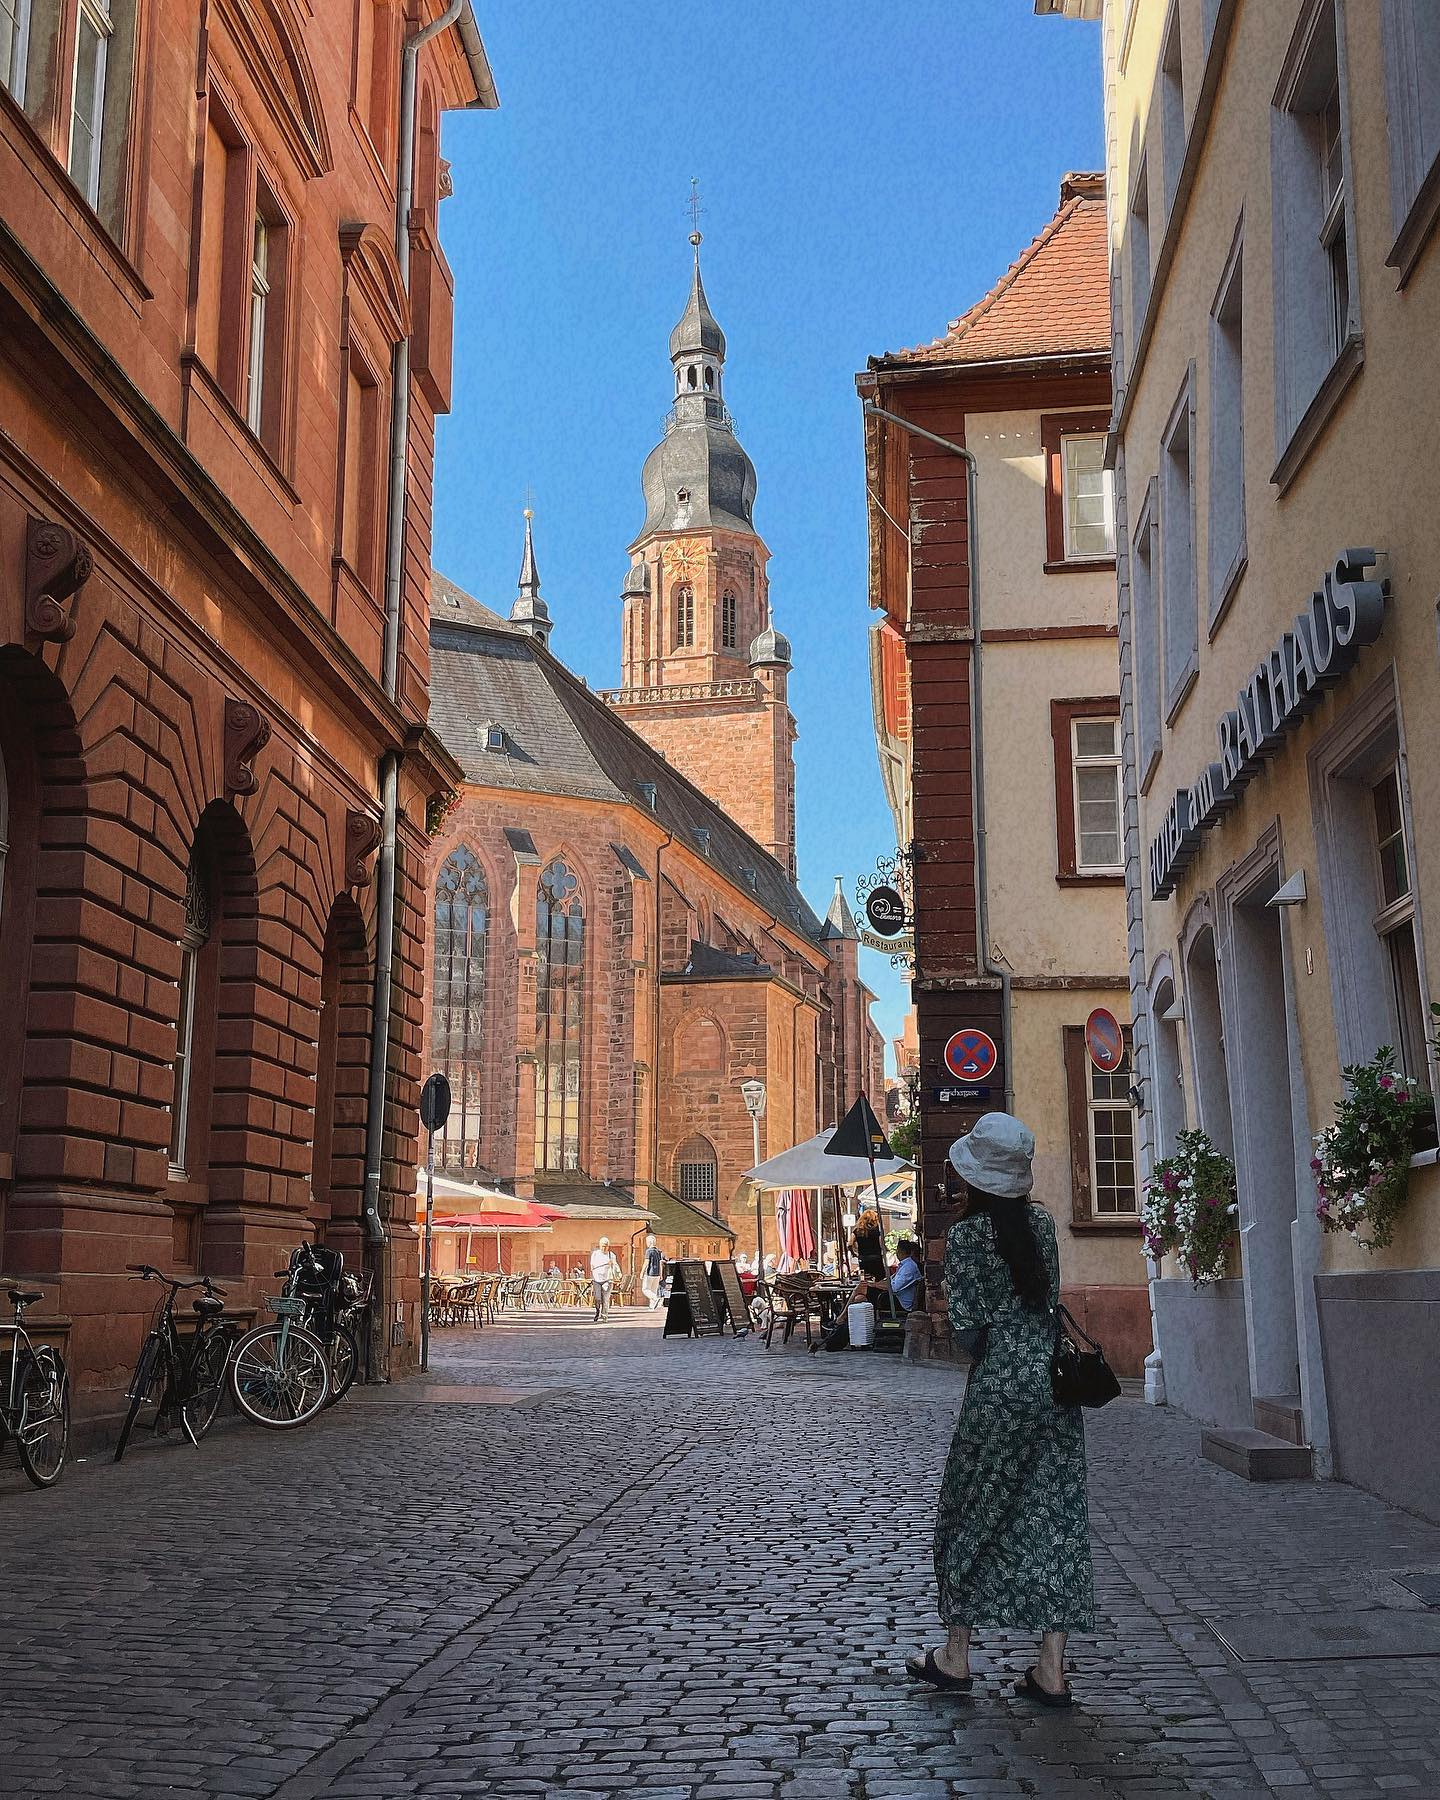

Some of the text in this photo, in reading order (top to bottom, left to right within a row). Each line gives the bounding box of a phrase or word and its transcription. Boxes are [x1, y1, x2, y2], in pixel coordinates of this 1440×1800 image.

[1150, 547, 1358, 897] HOTEL am RATHAUS
[863, 933, 912, 950] Restaurant
